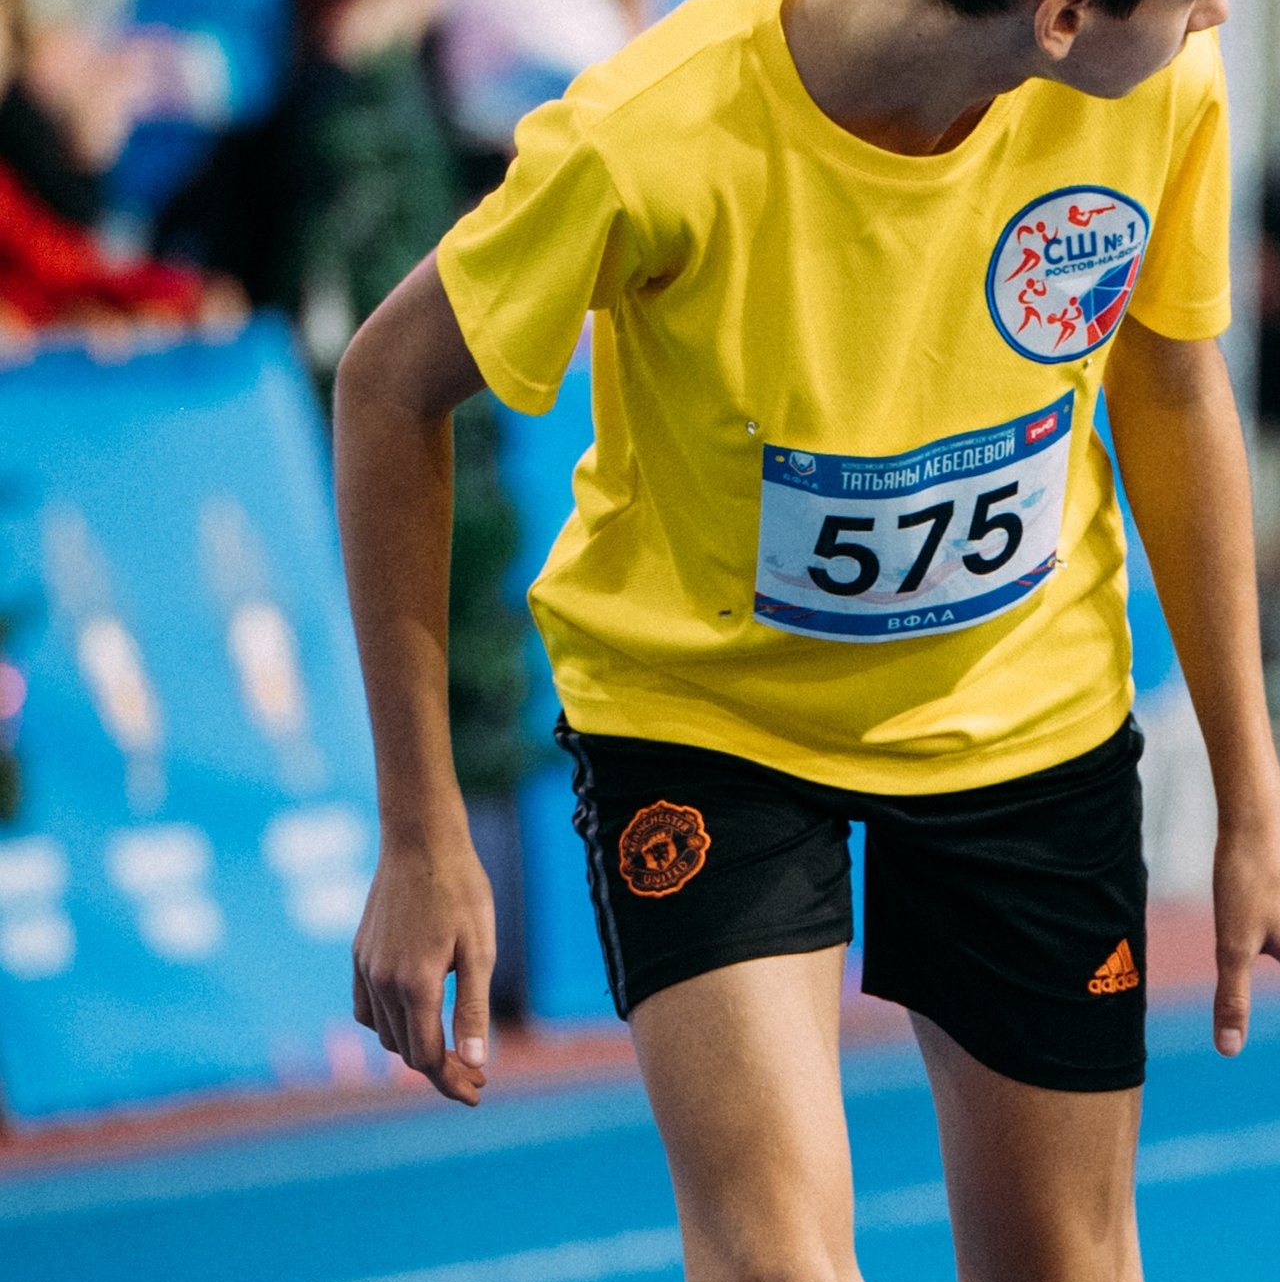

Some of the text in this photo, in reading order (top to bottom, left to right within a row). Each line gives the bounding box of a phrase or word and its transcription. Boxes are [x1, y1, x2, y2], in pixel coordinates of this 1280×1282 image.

[1044, 231, 1097, 265] СШ
[1127, 221, 1136, 243] 1
[841, 465, 920, 491] ТАТЬЯНЫ
[923, 433, 1015, 481] ЛЕБЕДЕВОЙ
[807, 481, 1023, 597] 575
[888, 609, 955, 630] ВФЛА
[643, 860, 689, 884] UNITED
[1088, 968, 1140, 995] adidas
